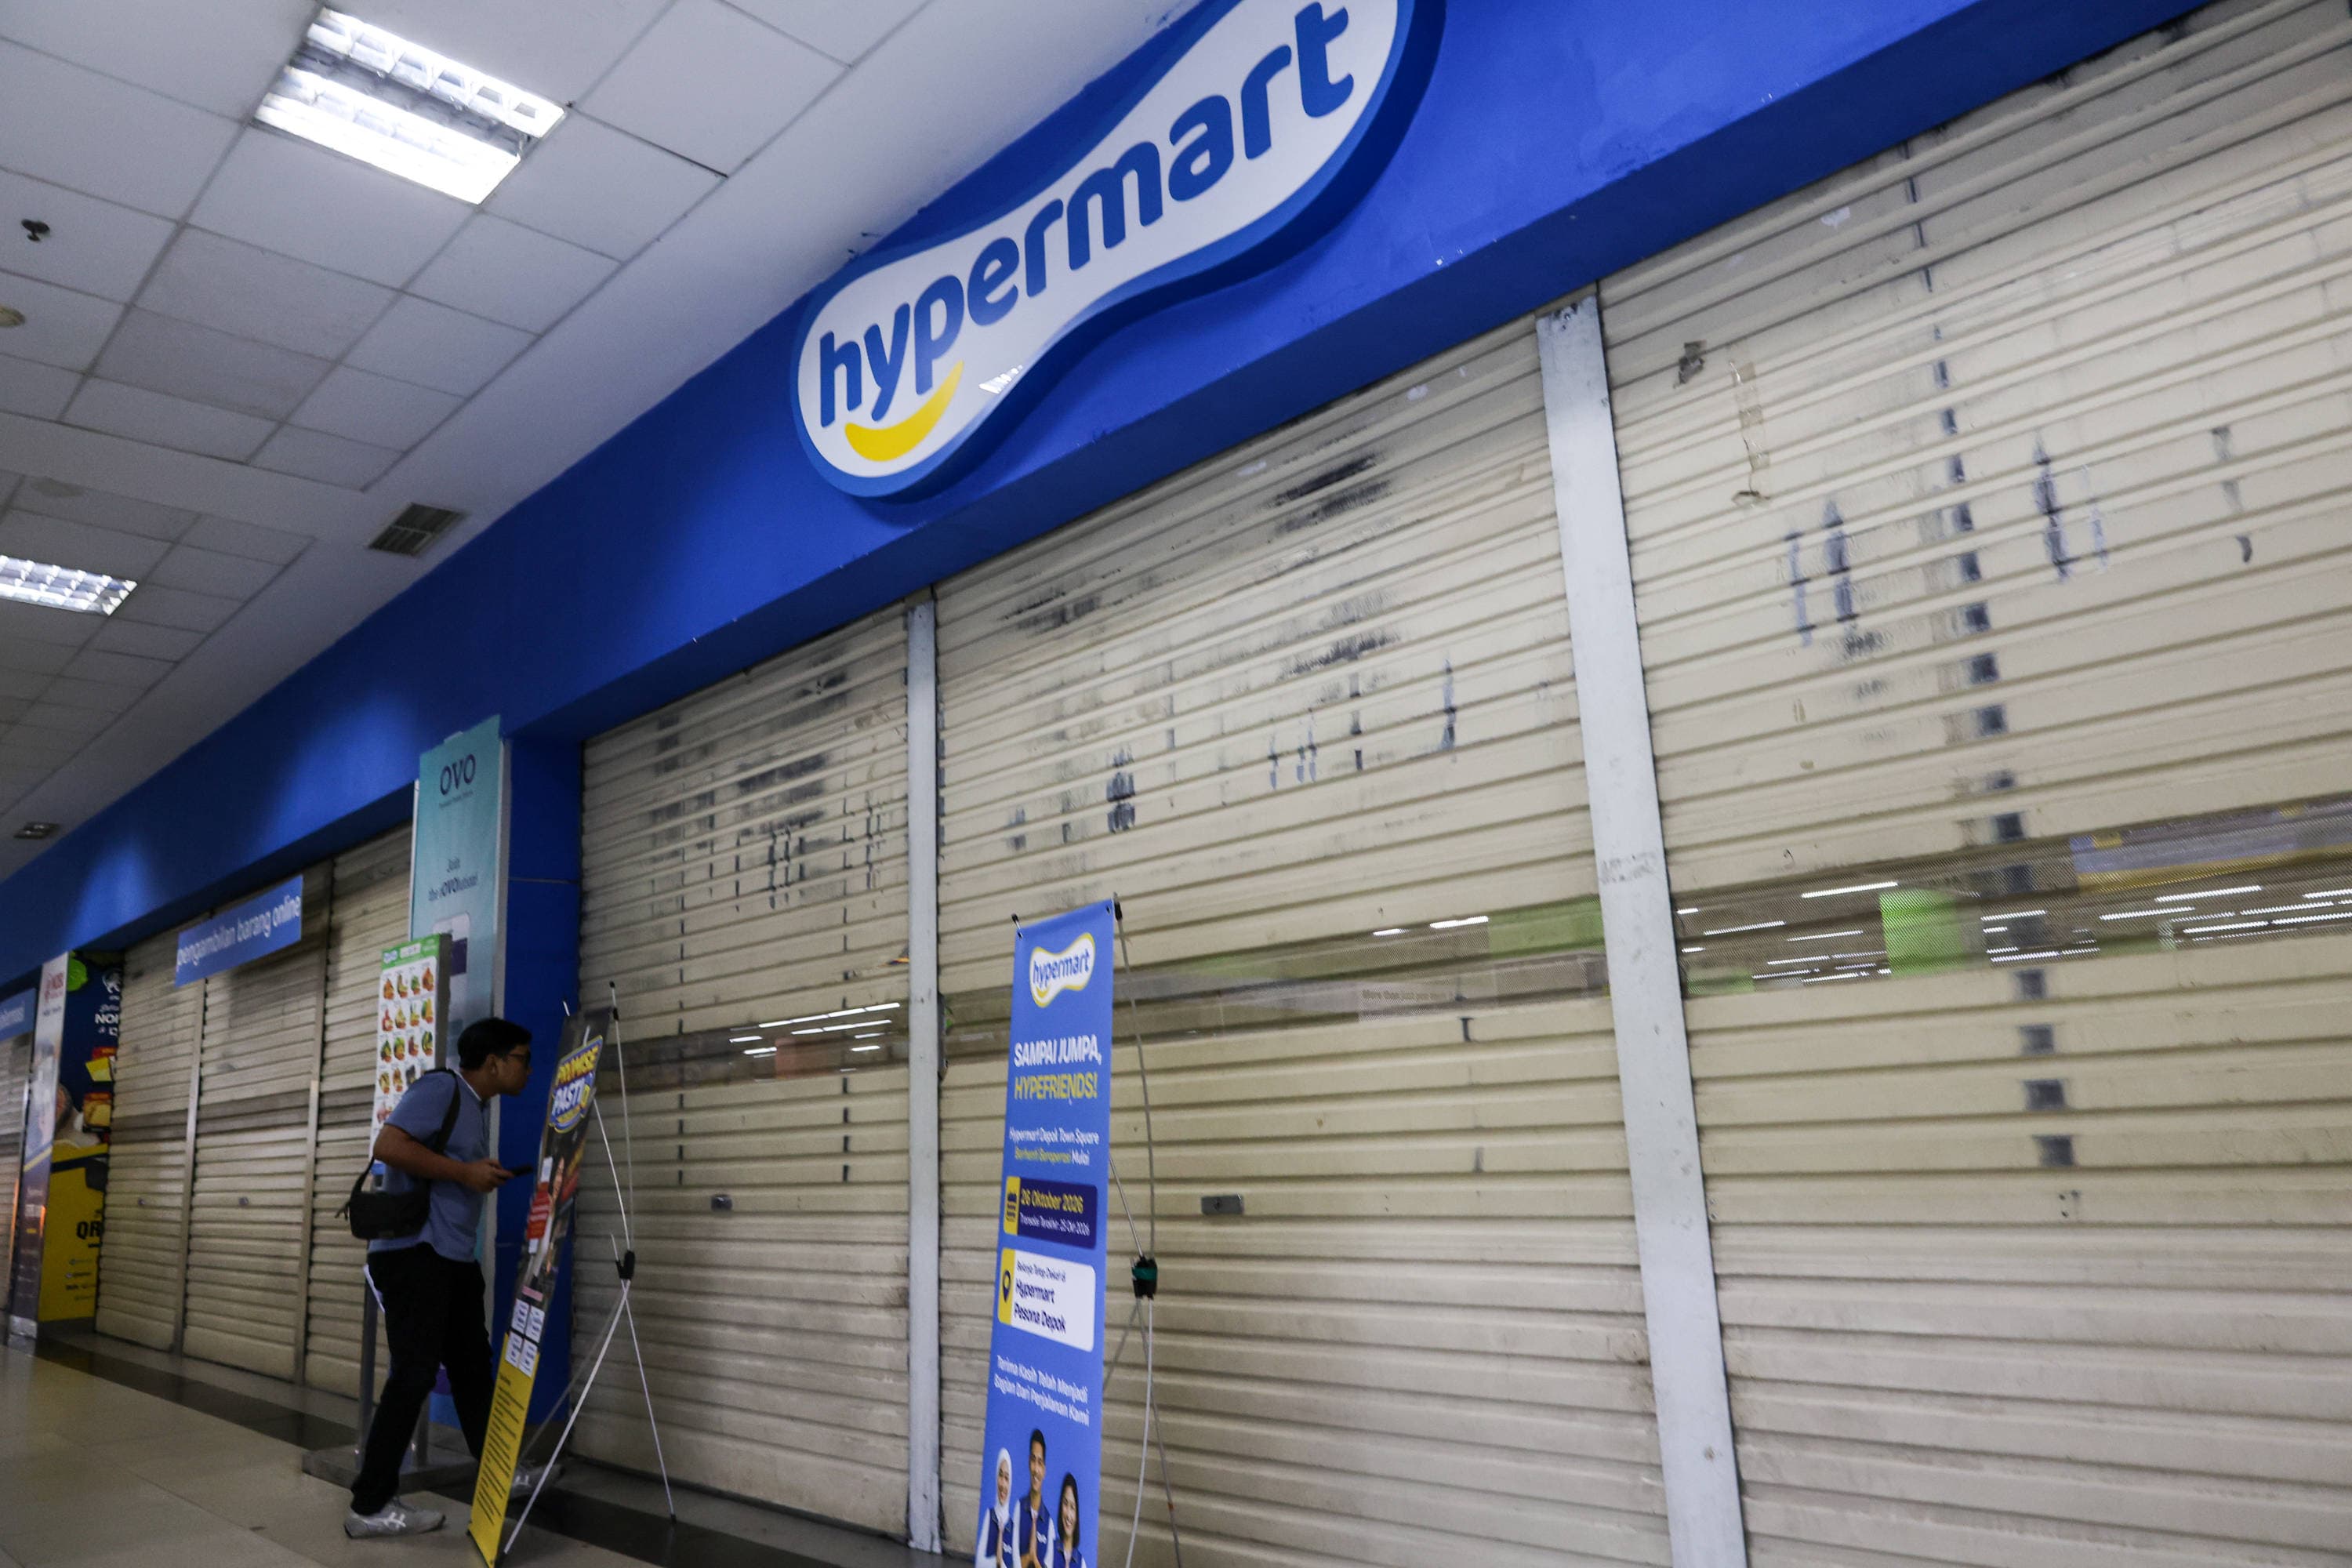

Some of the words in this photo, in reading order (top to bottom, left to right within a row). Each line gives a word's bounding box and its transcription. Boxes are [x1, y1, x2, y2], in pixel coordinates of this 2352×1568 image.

[820, 2, 1354, 428] hypermart
[440, 753, 476, 796] OVO
[237, 916, 271, 942] barang
[273, 895, 301, 927] online
[1033, 947, 1091, 989] hypermart
[1014, 1039, 1057, 1068] SAMPAI
[1057, 1033, 1102, 1066] JUMPA,
[1014, 1071, 1098, 1100] HYPEFRIENDS!
[1009, 1127, 1039, 1143] Hypermart
[1058, 1127, 1075, 1143] Town
[1075, 1127, 1099, 1147] Square
[1032, 1189, 1062, 1210] Oktober
[1014, 1278, 1054, 1305] Hypermart
[1014, 1301, 1040, 1325] Pesona
[1041, 1308, 1066, 1334] Depok
[1068, 1403, 1091, 1427] Kami
